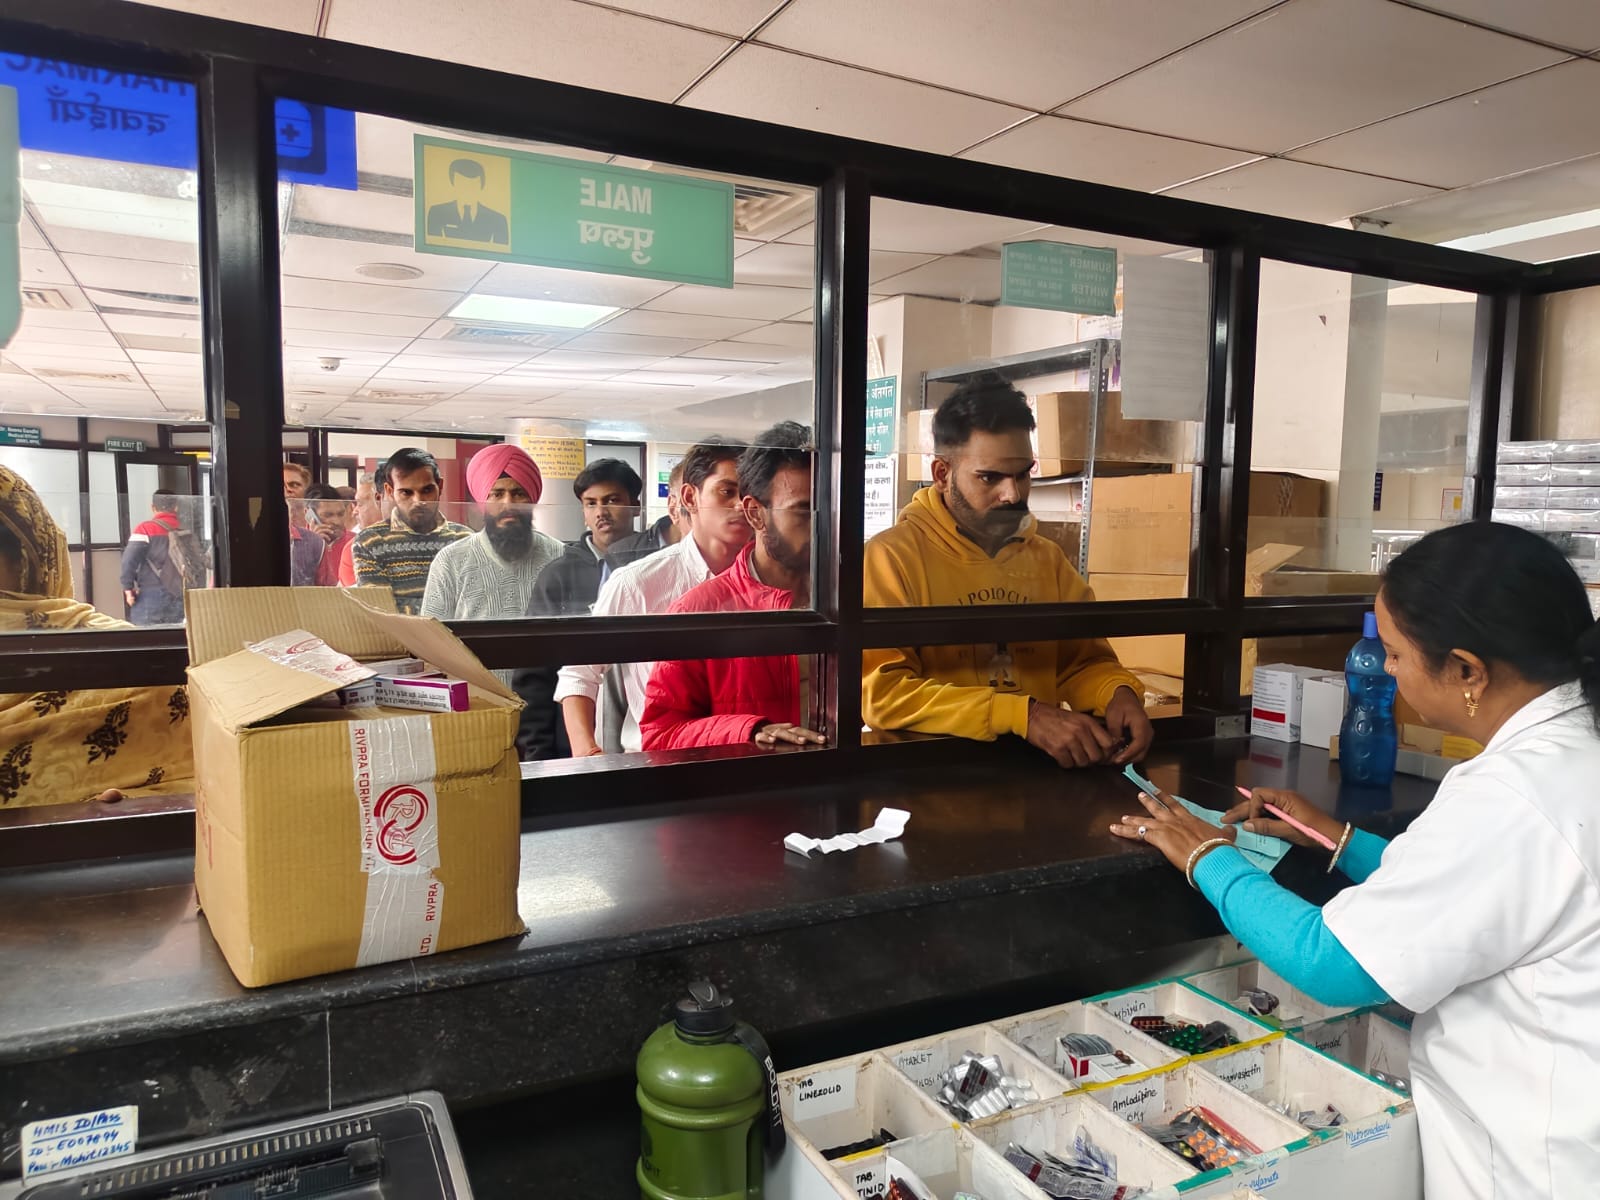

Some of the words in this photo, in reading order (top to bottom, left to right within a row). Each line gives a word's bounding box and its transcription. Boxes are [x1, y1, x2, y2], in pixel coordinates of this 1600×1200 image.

[122, 440, 136, 449] EXIT
[354, 728, 368, 769] RIVPRA
[425, 882, 439, 922] RIVPRA
[764, 1055, 783, 1127] BOLDFIT
[799, 1078, 814, 1090] TAB
[799, 1084, 842, 1101] LINEZOLID
[1112, 1087, 1158, 1113] Amlodipine
[33, 1121, 68, 1137] HMIS
